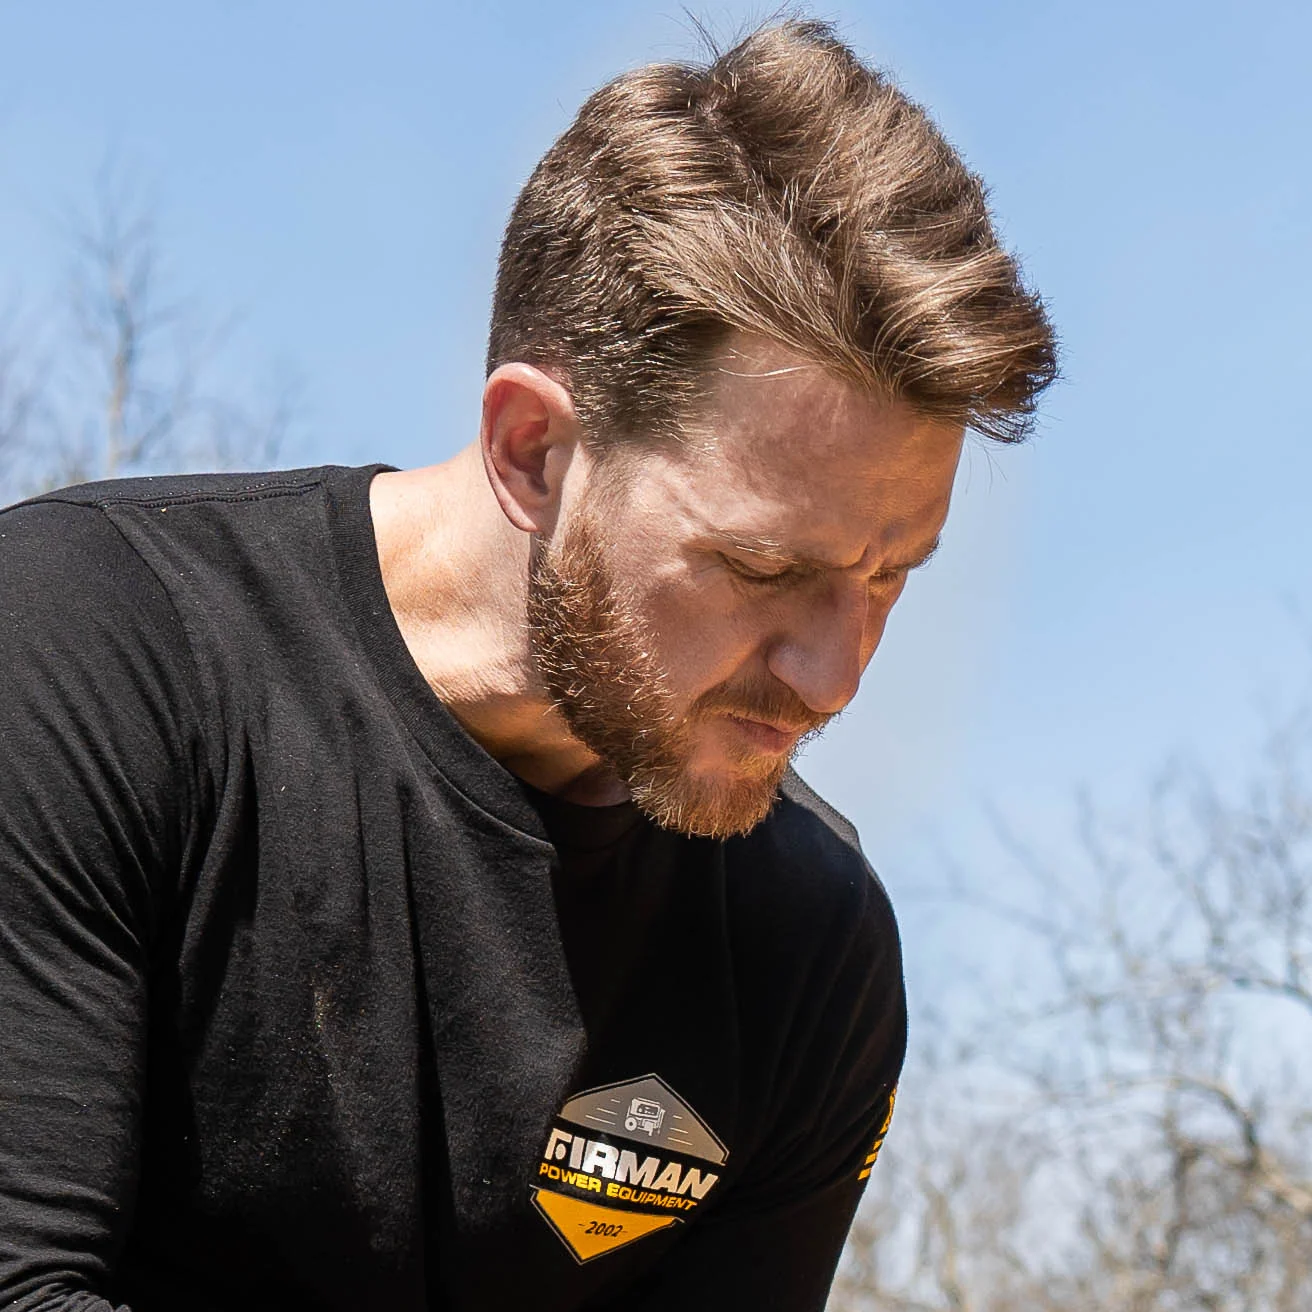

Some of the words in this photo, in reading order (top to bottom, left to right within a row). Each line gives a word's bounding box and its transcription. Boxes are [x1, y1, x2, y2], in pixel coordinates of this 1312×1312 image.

[539, 1162, 601, 1193] POWER
[606, 1182, 698, 1211] EQUIPMENT
[544, 1127, 719, 1200] FIRMAN
[585, 1221, 624, 1237] 2002
